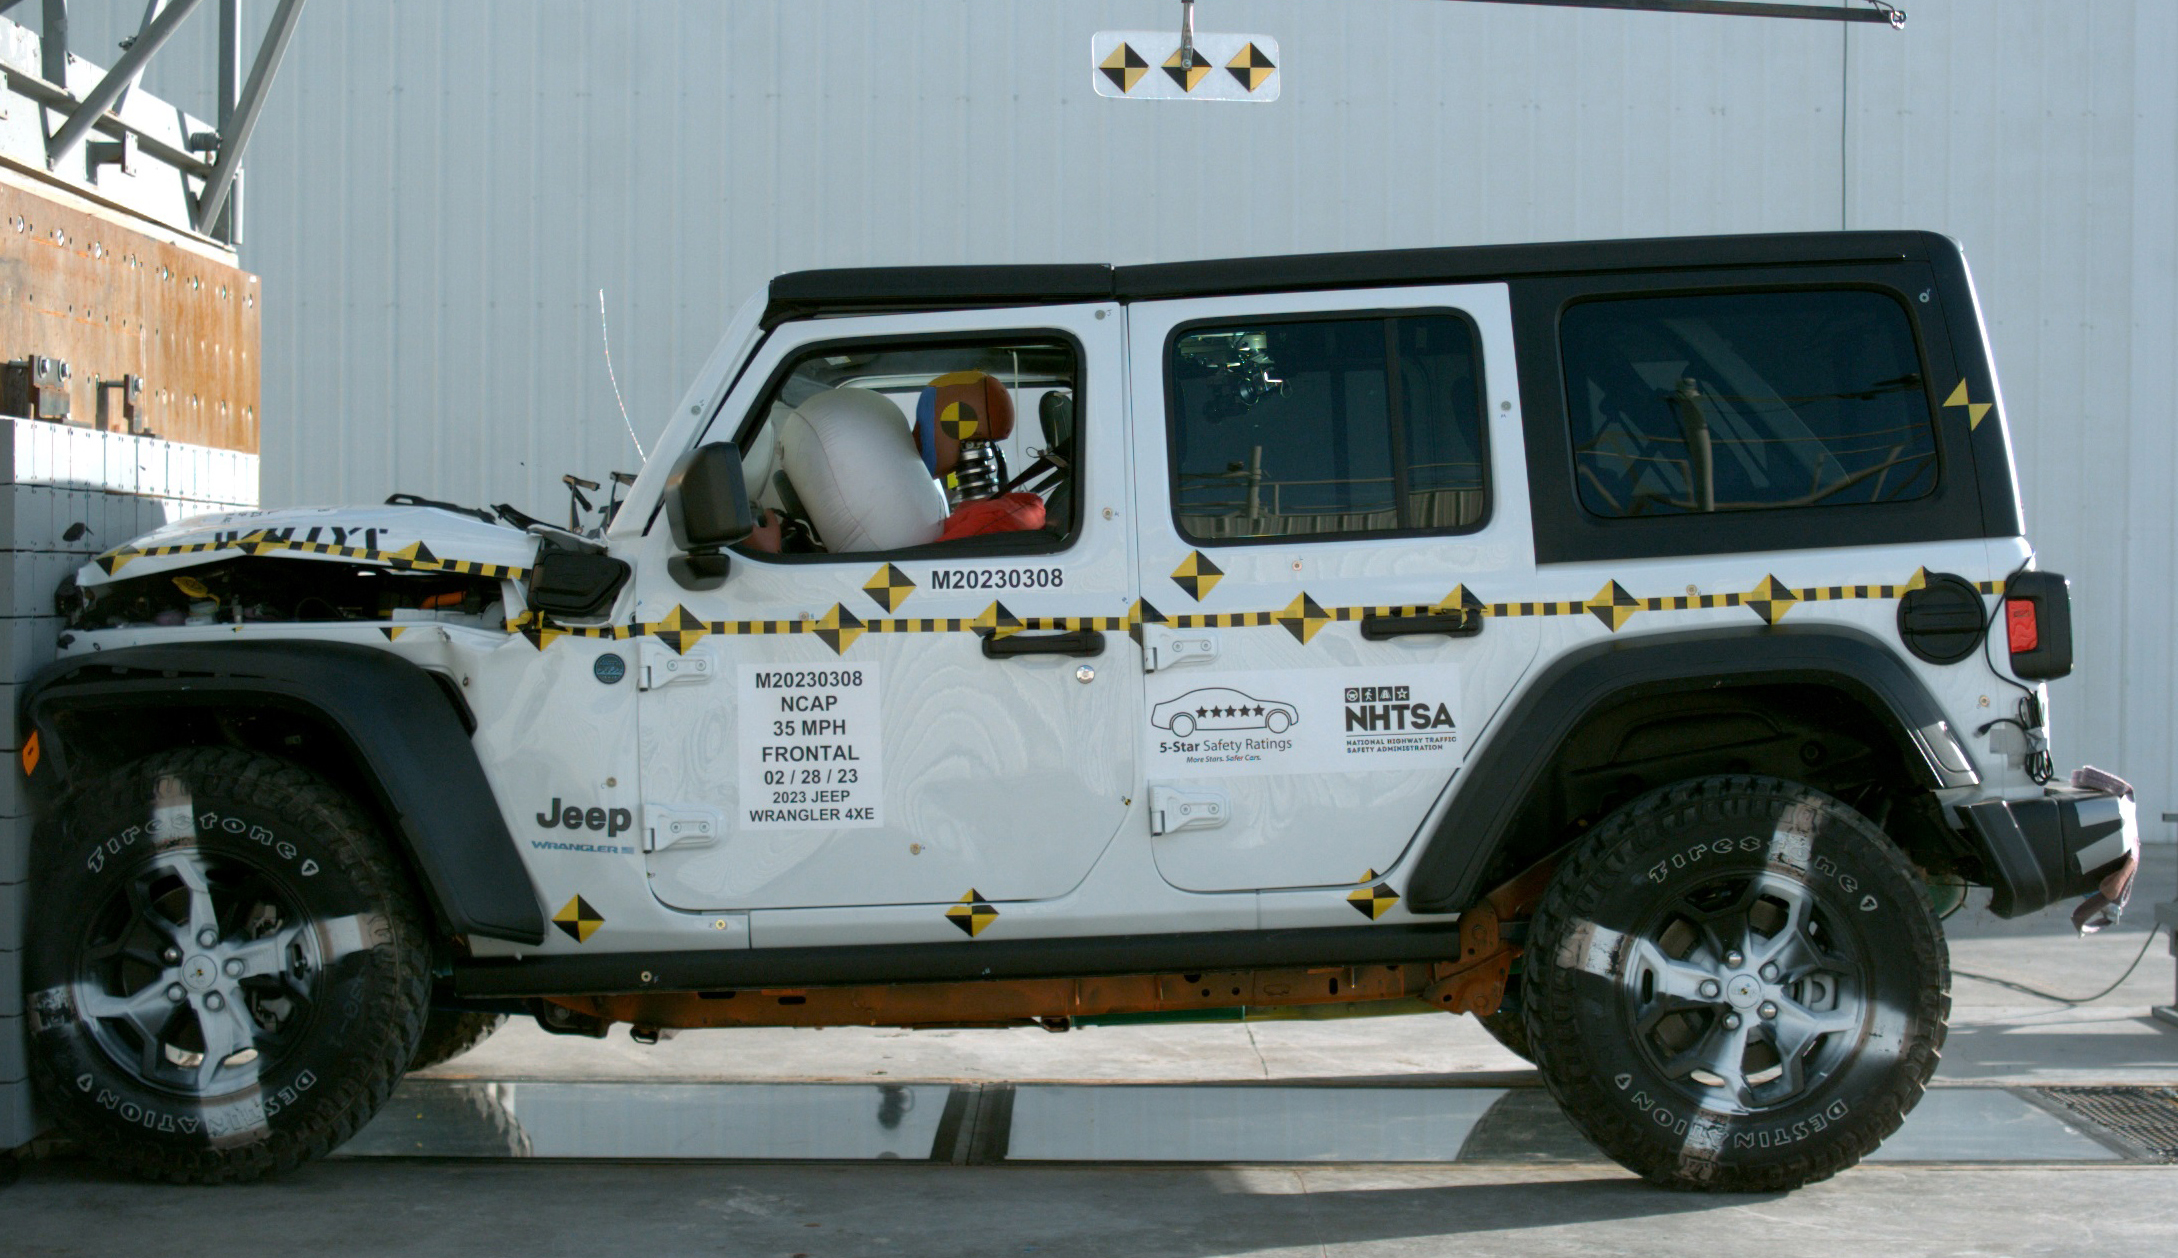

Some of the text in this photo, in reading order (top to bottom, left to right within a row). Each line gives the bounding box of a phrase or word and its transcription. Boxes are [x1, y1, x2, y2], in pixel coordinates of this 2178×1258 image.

[931, 568, 1063, 589] M20230308
[756, 671, 863, 689] M20230308
[781, 695, 838, 712] NCAP
[1345, 702, 1456, 732] NHTSA
[773, 719, 846, 736] 35 MPH
[762, 745, 860, 763] FRONTAL
[1159, 738, 1292, 753] 5-Star Safety Ratings
[1377, 744, 1443, 752] ADMINISTRATION
[1205, 755, 1224, 763] Stars.
[1226, 754, 1244, 762] Safer
[764, 770, 785, 785] 02
[801, 769, 821, 784] 28
[837, 768, 858, 784] 23
[773, 790, 850, 804] 2023 JEEP
[536, 797, 632, 838] Jeep
[749, 807, 875, 823] WRANGLER 4XE
[531, 840, 619, 854] WRANGLER
[96, 1068, 318, 1138] DESTINATION
[1630, 1091, 1849, 1149] DESTINATION
